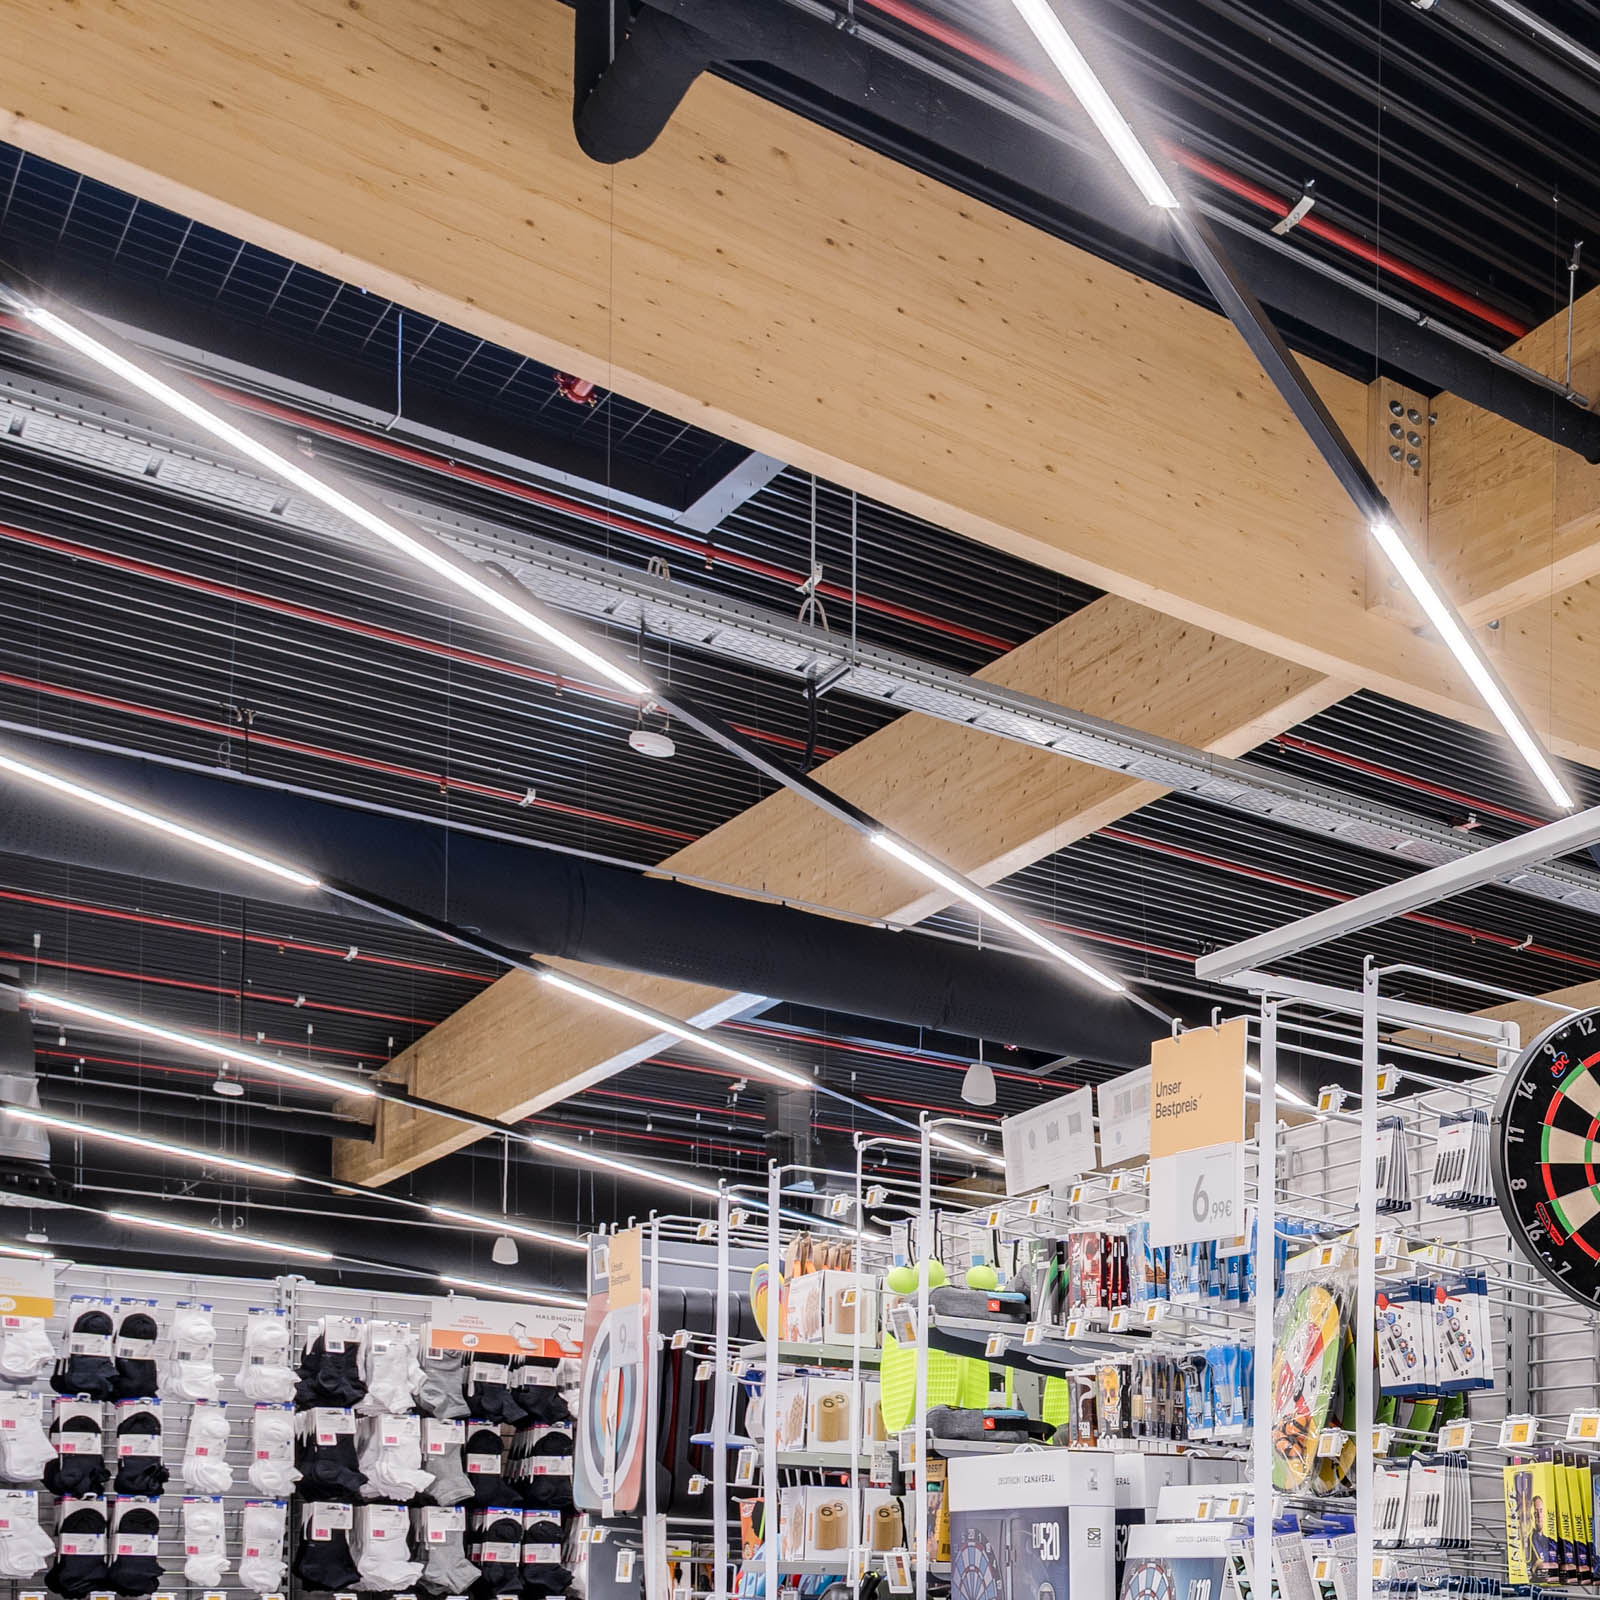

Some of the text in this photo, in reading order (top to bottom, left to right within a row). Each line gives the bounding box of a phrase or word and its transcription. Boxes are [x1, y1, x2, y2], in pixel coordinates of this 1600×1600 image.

[1544, 1043, 1557, 1059] 9
[1551, 1055, 1570, 1075] PDC
[1155, 1080, 1182, 1098] Unser
[1155, 1096, 1198, 1119] Bestpreis
[1510, 1178, 1528, 1190] 8
[1526, 1220, 1545, 1242] 16
[1559, 1261, 1573, 1277] 7
